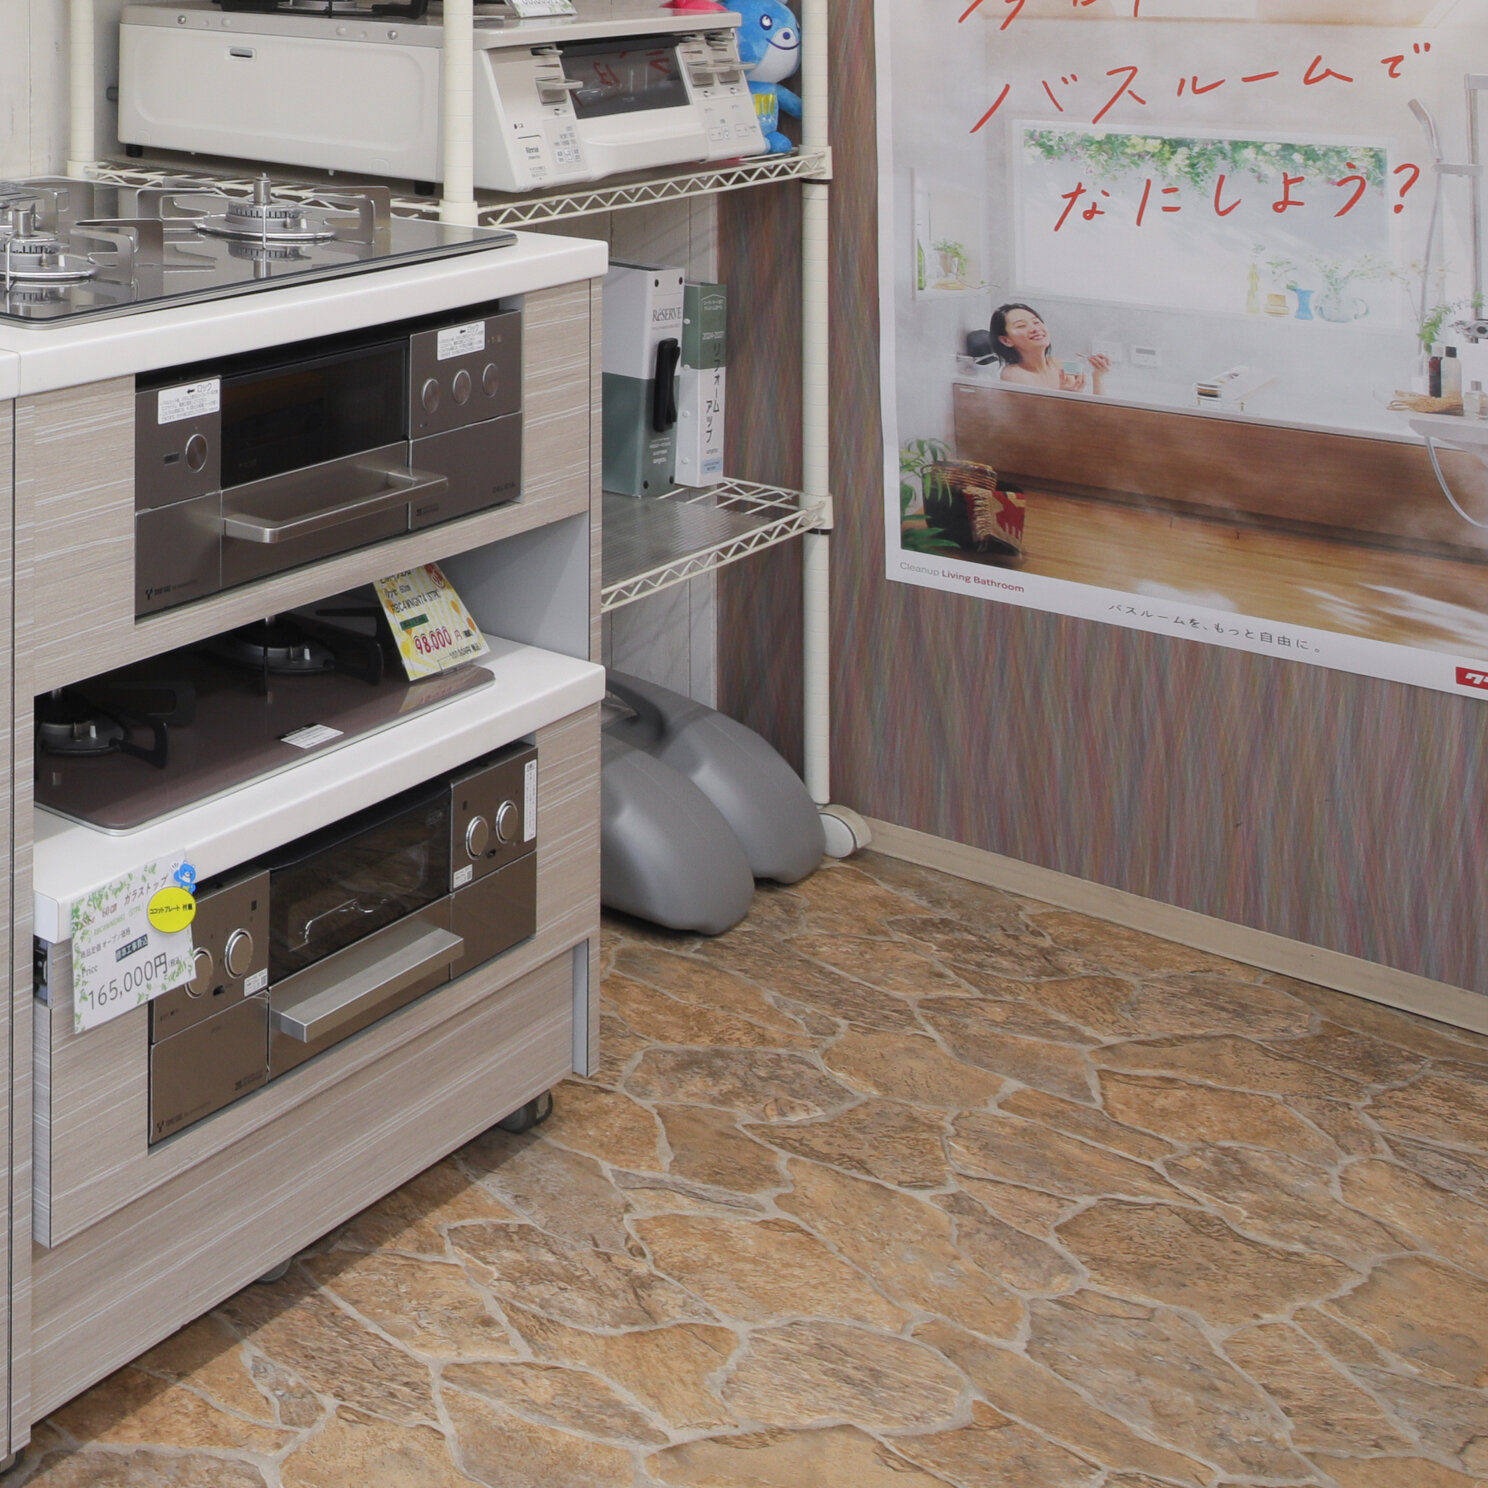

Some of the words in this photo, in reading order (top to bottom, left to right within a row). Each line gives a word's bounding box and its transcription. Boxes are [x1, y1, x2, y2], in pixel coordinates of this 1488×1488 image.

[969, 41, 1433, 134] バスルームで
[712, 343, 721, 413] リフォーム
[705, 400, 714, 444] アップ
[900, 561, 940, 578] Cleanup
[941, 568, 971, 585] Living
[973, 573, 1024, 594] Bathroom
[124, 875, 168, 906] ガラストップ
[149, 905, 180, 915] ココットプレート
[88, 952, 167, 1010] 165,000円
